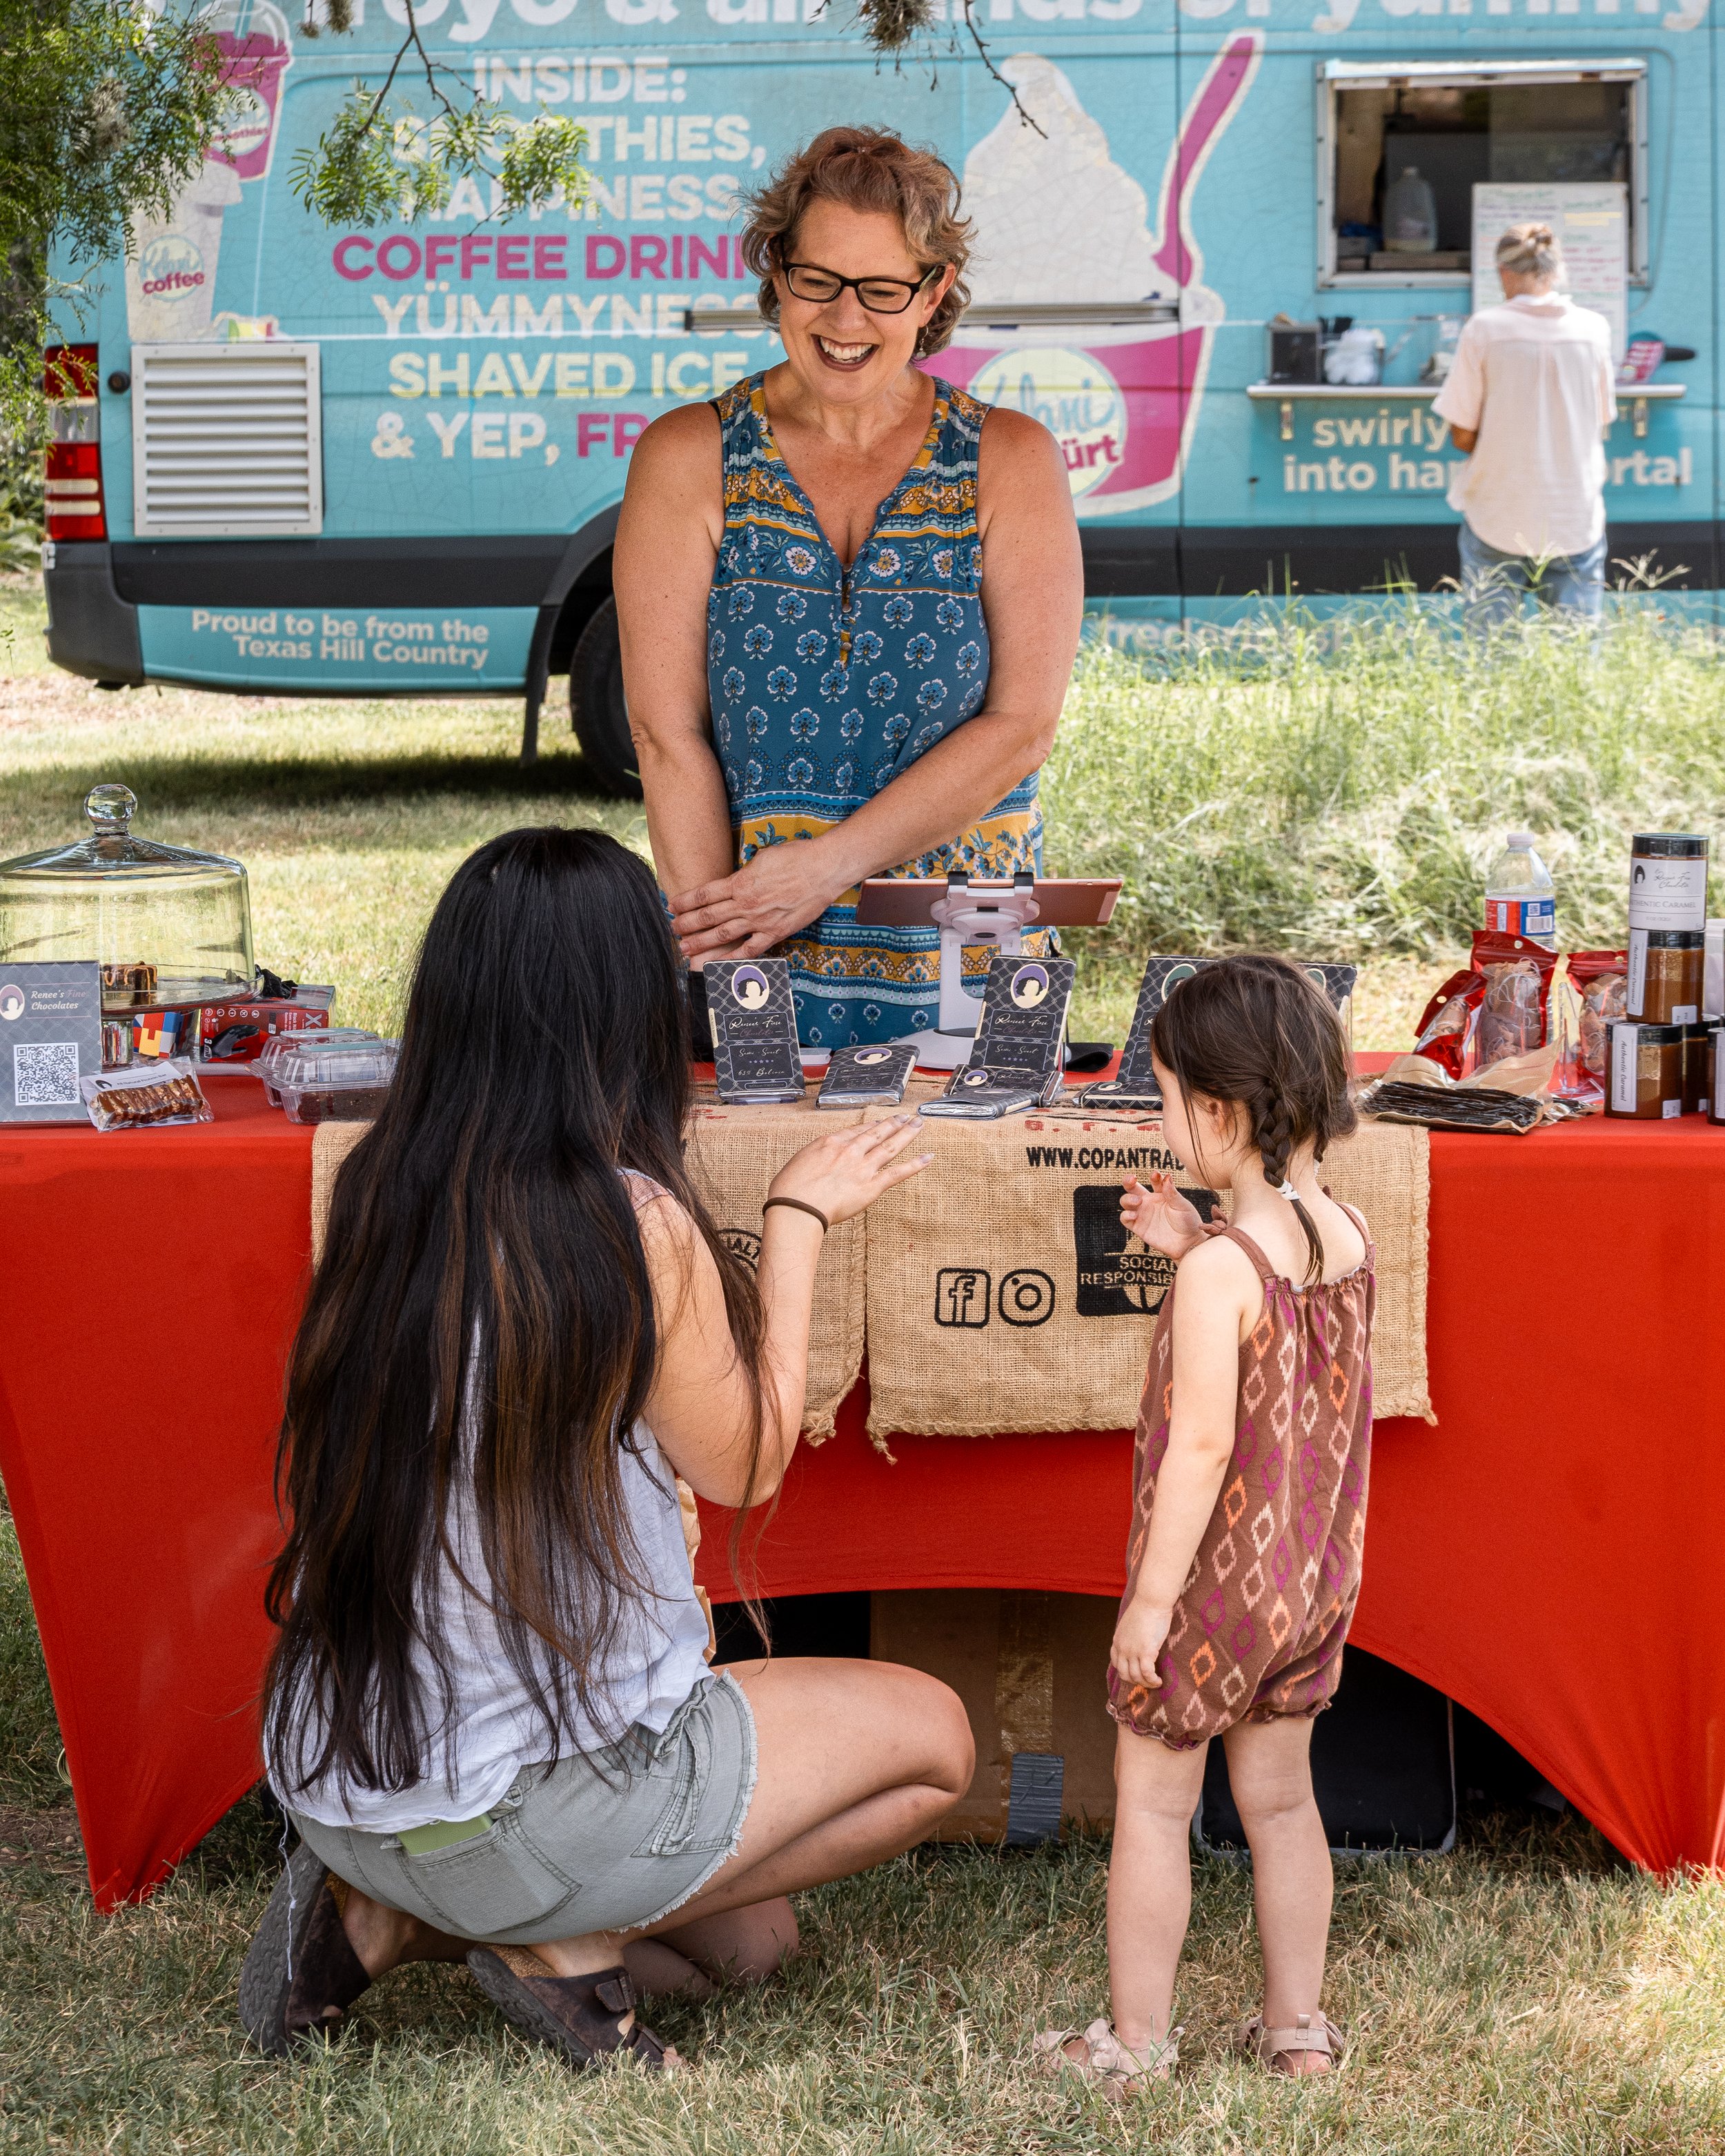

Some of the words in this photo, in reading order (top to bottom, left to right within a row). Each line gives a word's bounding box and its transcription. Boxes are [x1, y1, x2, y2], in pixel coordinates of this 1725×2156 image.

[473, 56, 688, 103] INSIDE:
[331, 234, 569, 281] COFFEE
[142, 270, 205, 295] coffee
[388, 352, 636, 399] SHAVED
[650, 352, 749, 399] ICE
[371, 411, 415, 459] &
[426, 412, 560, 465] YEP,
[1313, 407, 1452, 451] swirly
[1284, 454, 1376, 492] into
[1604, 447, 1693, 486] rtal
[192, 609, 277, 635] Proud
[284, 612, 314, 635] to
[322, 613, 358, 638] be
[365, 615, 434, 640] from
[442, 619, 489, 643] the
[233, 634, 313, 659] Texas
[319, 637, 365, 661] Hill
[373, 640, 489, 671] Country
[31, 989, 65, 999] Renee's
[68, 989, 86, 998] Fine
[31, 1000, 79, 1010] Chocolates
